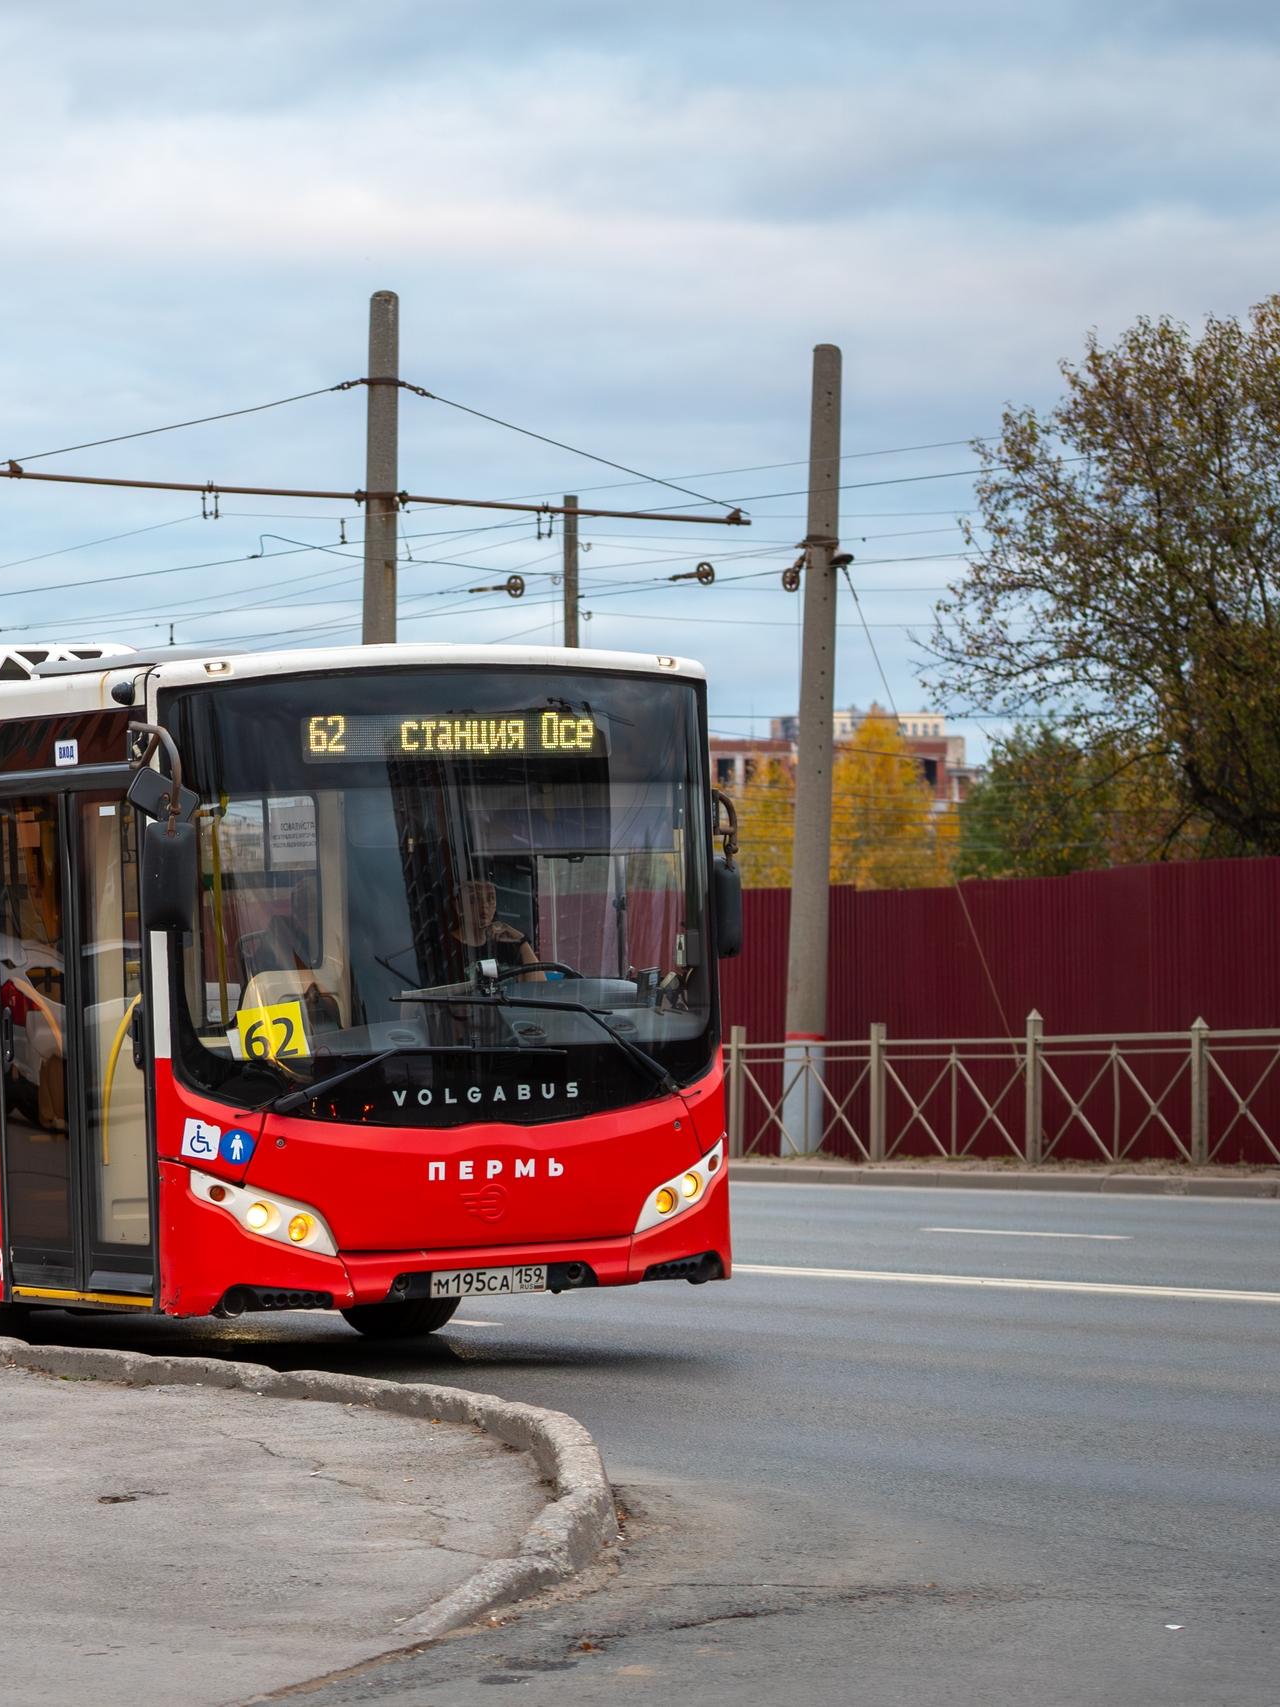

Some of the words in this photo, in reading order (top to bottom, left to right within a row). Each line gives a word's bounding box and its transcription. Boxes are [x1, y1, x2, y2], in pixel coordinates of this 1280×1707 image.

[309, 715, 346, 752] 62
[401, 720, 524, 754] станция
[541, 712, 594, 749] Осе
[58, 745, 74, 759] ВХОД
[245, 1017, 299, 1060] 62
[392, 1081, 580, 1107] VOLGABUS
[428, 1157, 565, 1181] ПЕРМЬ
[437, 1271, 511, 1295] М195СА
